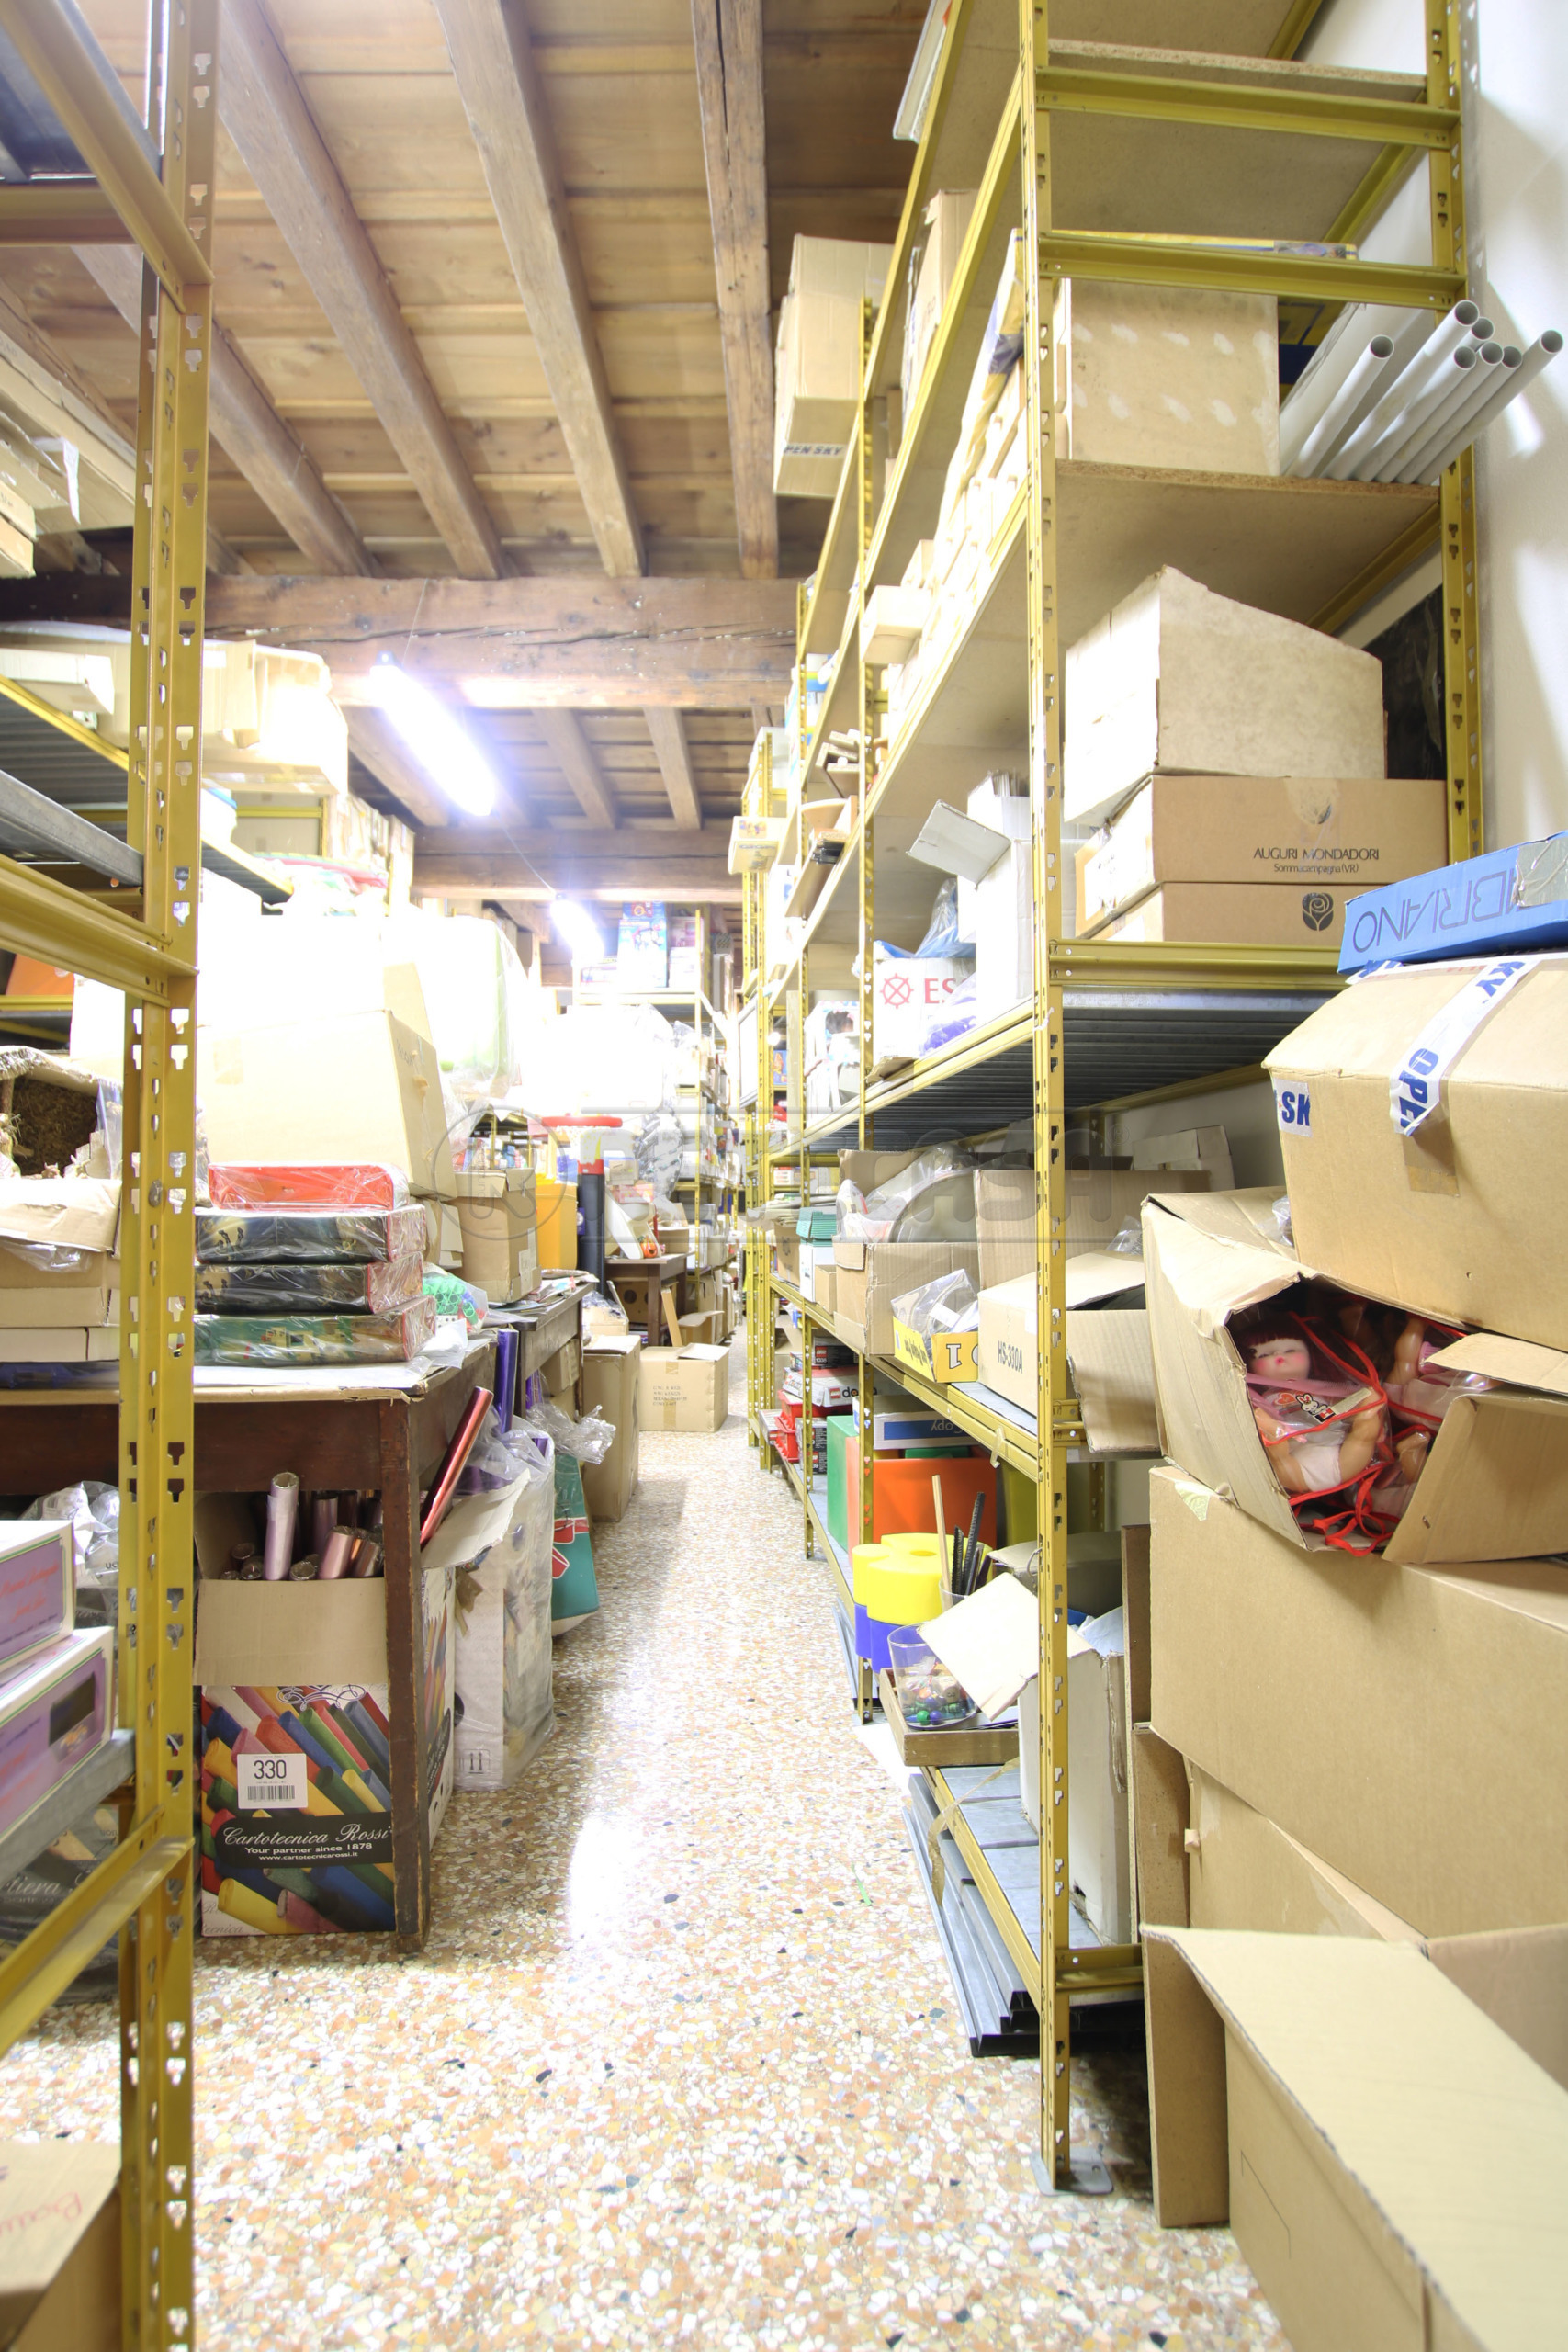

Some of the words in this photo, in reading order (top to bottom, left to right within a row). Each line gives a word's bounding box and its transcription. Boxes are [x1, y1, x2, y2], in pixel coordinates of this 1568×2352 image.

[813, 446, 842, 455] SKY
[1253, 847, 1298, 860] AUGURI
[1303, 848, 1380, 860] MONDADORI
[1353, 868, 1543, 953] BRIANO
[254, 1759, 287, 1780] 330
[223, 1826, 329, 1846] Cartotecnica
[335, 1823, 391, 1843] Rossi
[259, 1851, 359, 1860] www.cartotecnicarossi.it
[273, 1846, 301, 1855] partner
[315, 1845, 343, 1853] since
